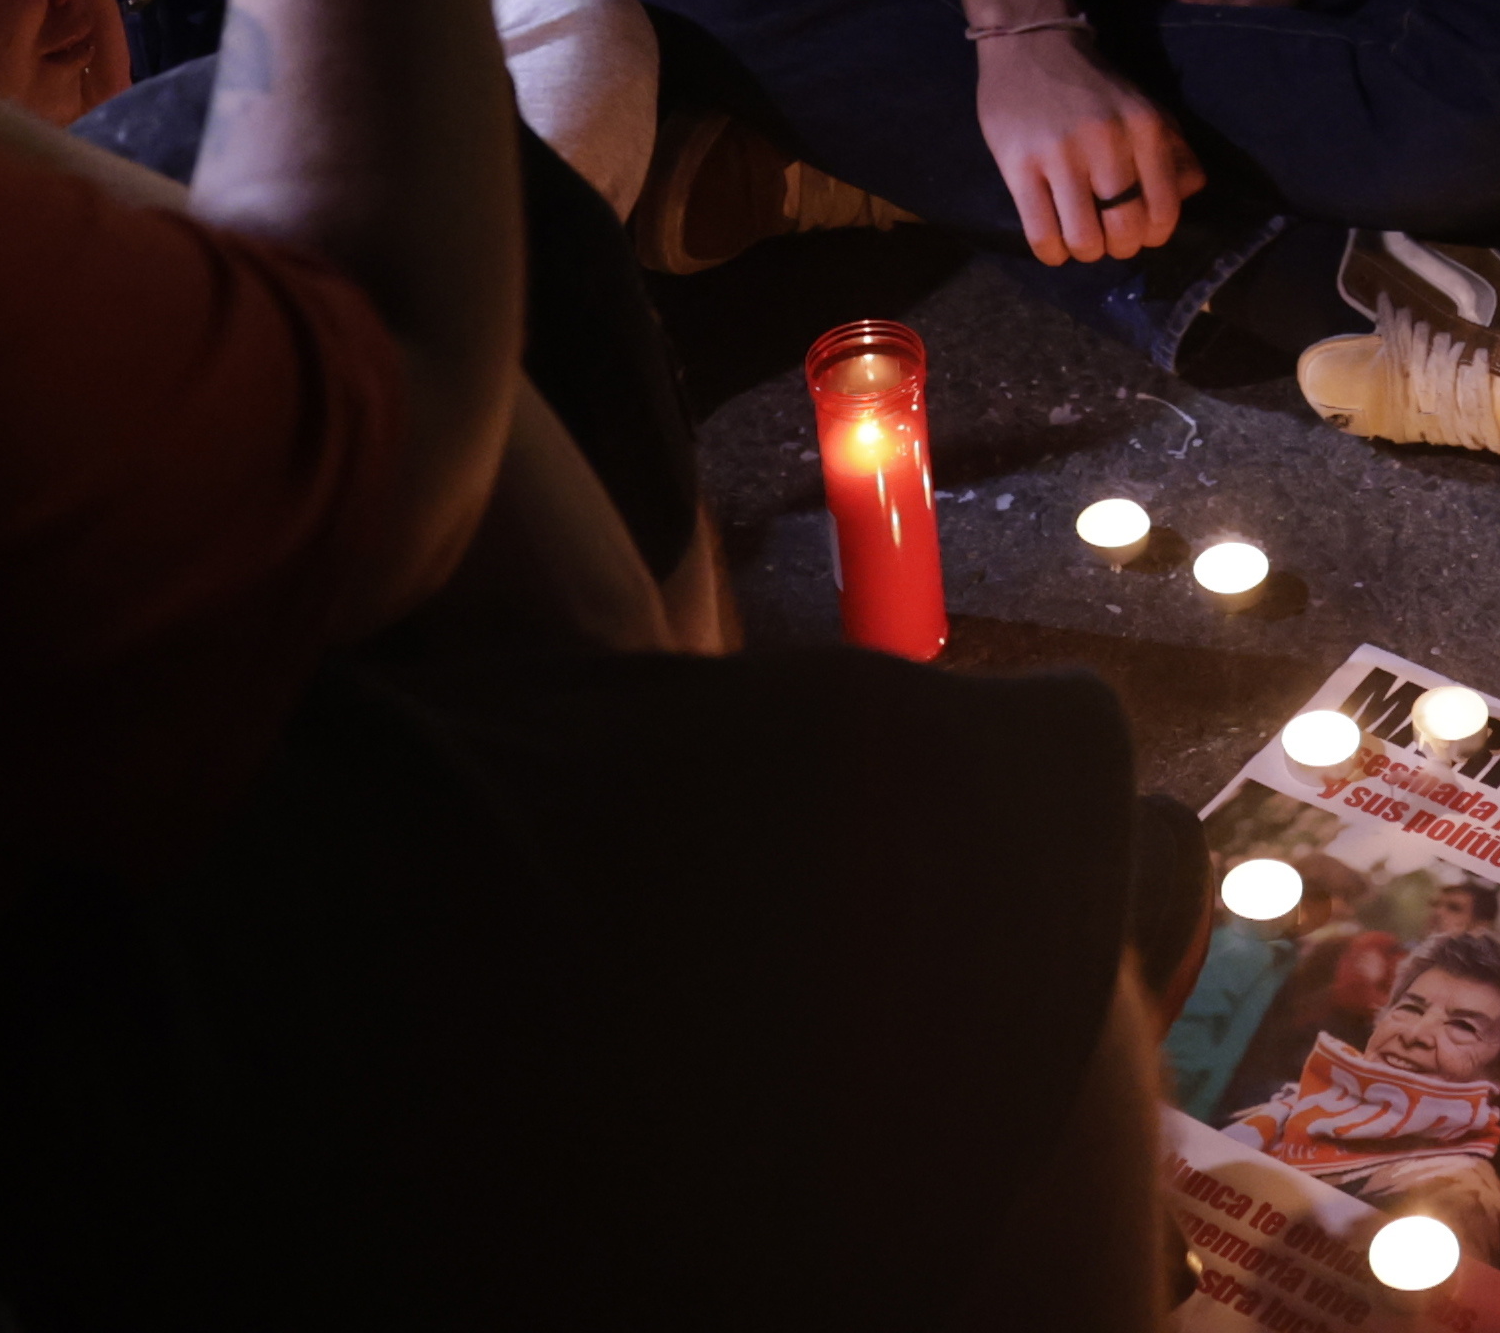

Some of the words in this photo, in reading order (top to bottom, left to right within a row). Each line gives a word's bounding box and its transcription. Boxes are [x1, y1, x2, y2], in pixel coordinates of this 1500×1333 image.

[1343, 786, 1411, 823] sus
[1351, 745, 1497, 822] sesinada
[1250, 1201, 1288, 1235] te
[1197, 1269, 1264, 1317] stra
